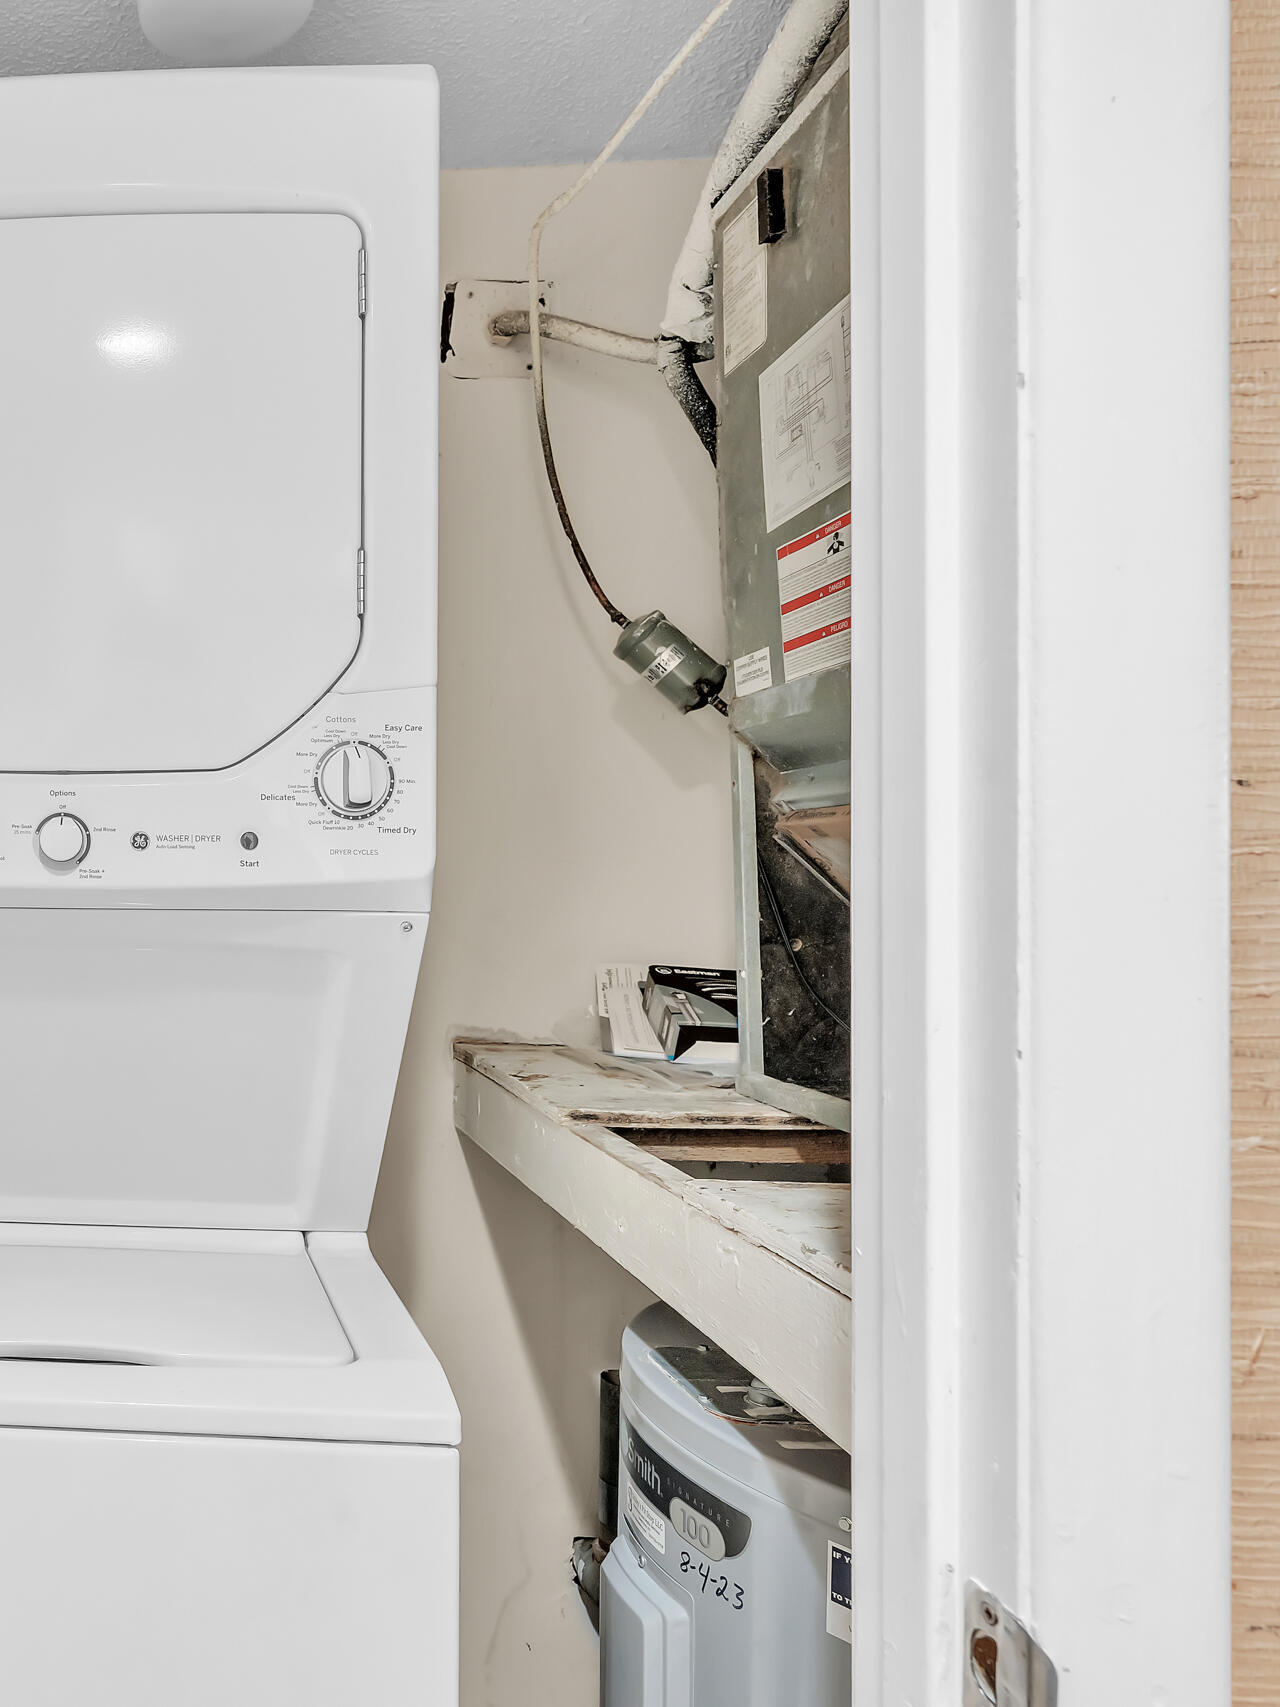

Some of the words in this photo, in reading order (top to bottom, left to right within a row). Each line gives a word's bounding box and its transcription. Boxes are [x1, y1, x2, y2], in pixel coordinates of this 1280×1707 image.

[824, 520, 842, 535] DANGER
[385, 724, 403, 732] Easy
[403, 827, 417, 836] Dry
[627, 1436, 662, 1497] Smith
[680, 1507, 711, 1550] 100
[833, 1551, 842, 1560] IF
[679, 1551, 746, 1610] 8-4-23
[832, 1592, 843, 1601] TO
